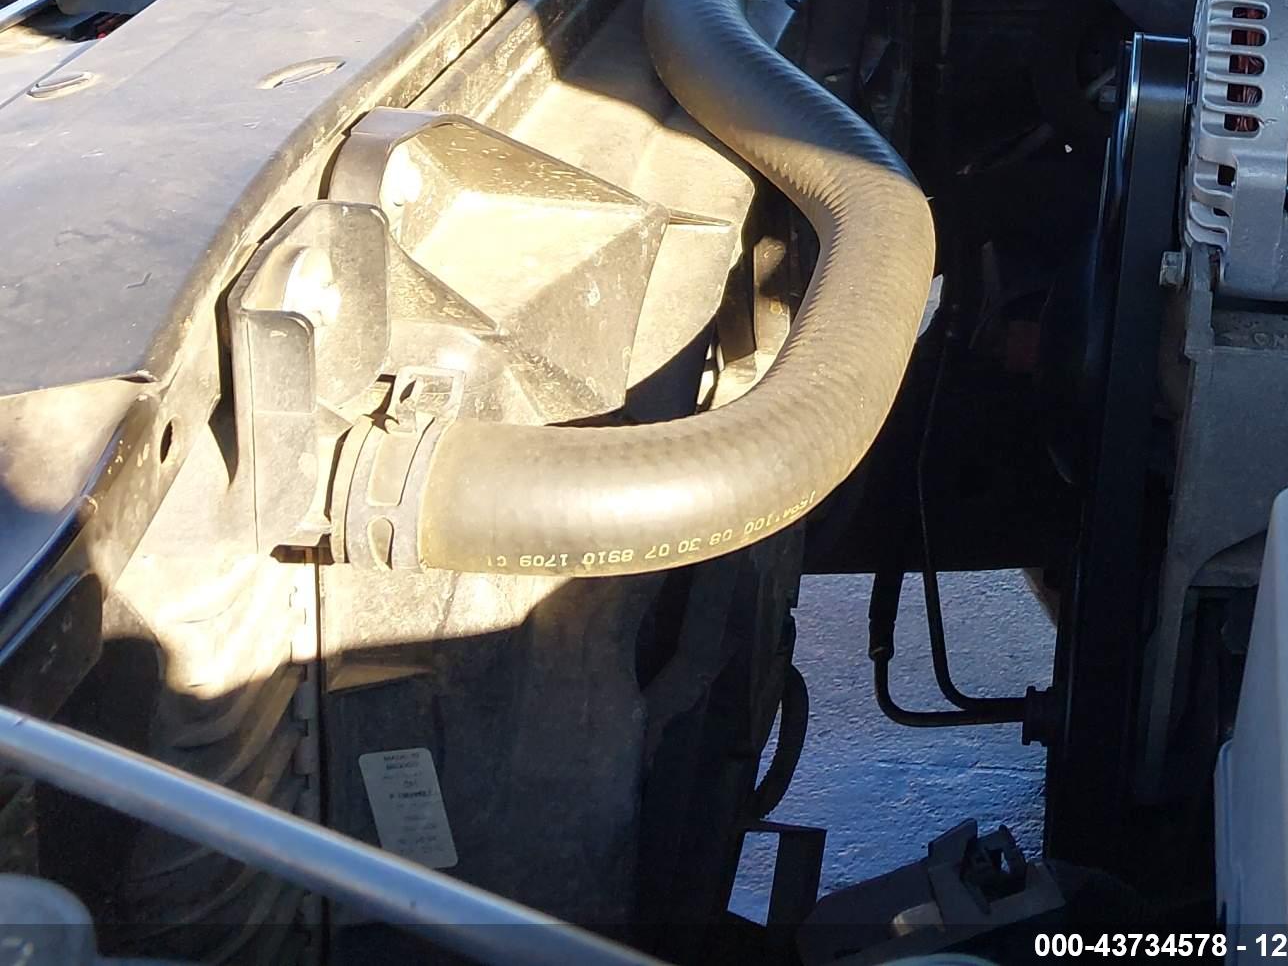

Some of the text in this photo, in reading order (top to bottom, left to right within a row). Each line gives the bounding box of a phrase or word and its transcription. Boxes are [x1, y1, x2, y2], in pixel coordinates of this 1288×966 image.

[677, 537, 702, 554] 30
[708, 528, 733, 546] 08
[519, 553, 569, 568] 1709
[582, 548, 634, 566] 8910
[644, 543, 670, 561] 07
